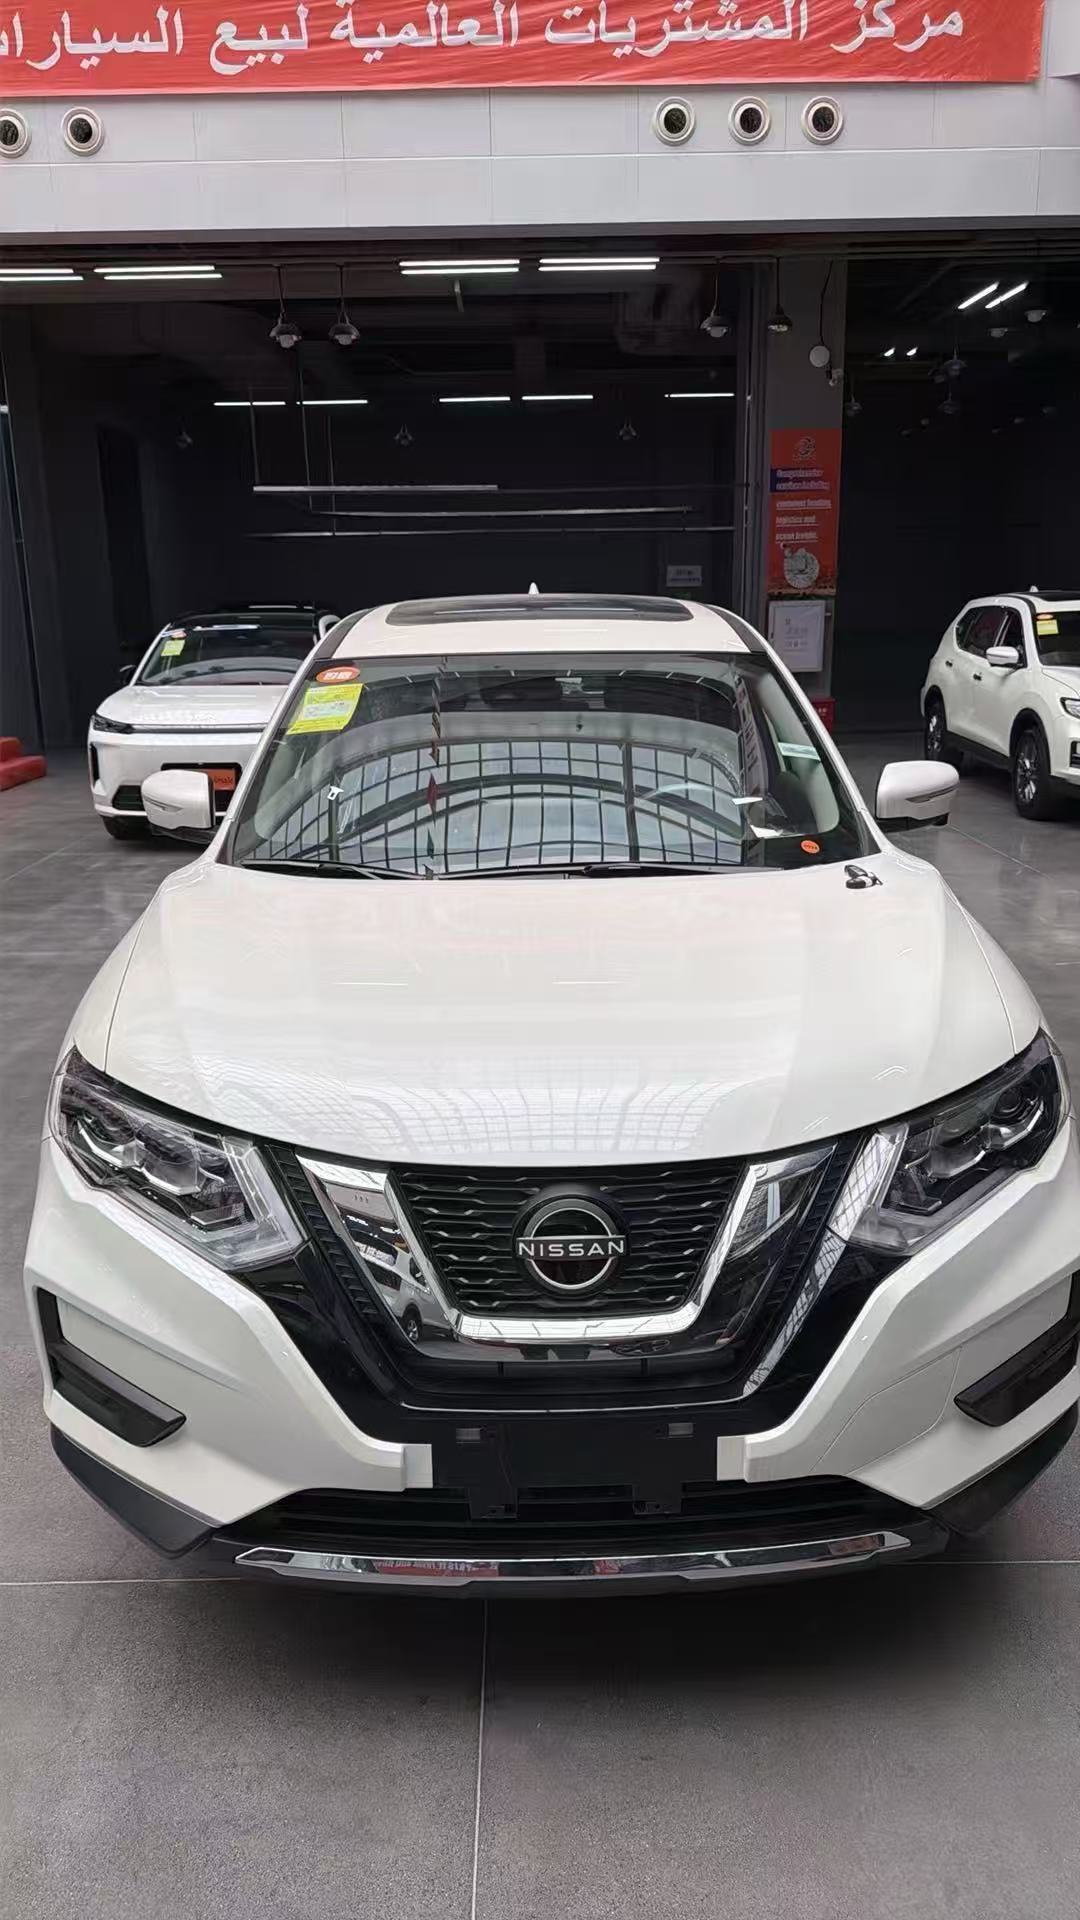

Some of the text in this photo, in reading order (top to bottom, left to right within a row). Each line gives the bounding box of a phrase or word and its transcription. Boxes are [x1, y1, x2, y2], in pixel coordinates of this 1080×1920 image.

[0, 0, 964, 75] مركز المشتريات العالمية لبيع السيارا
[519, 1240, 623, 1257] NISSAN
